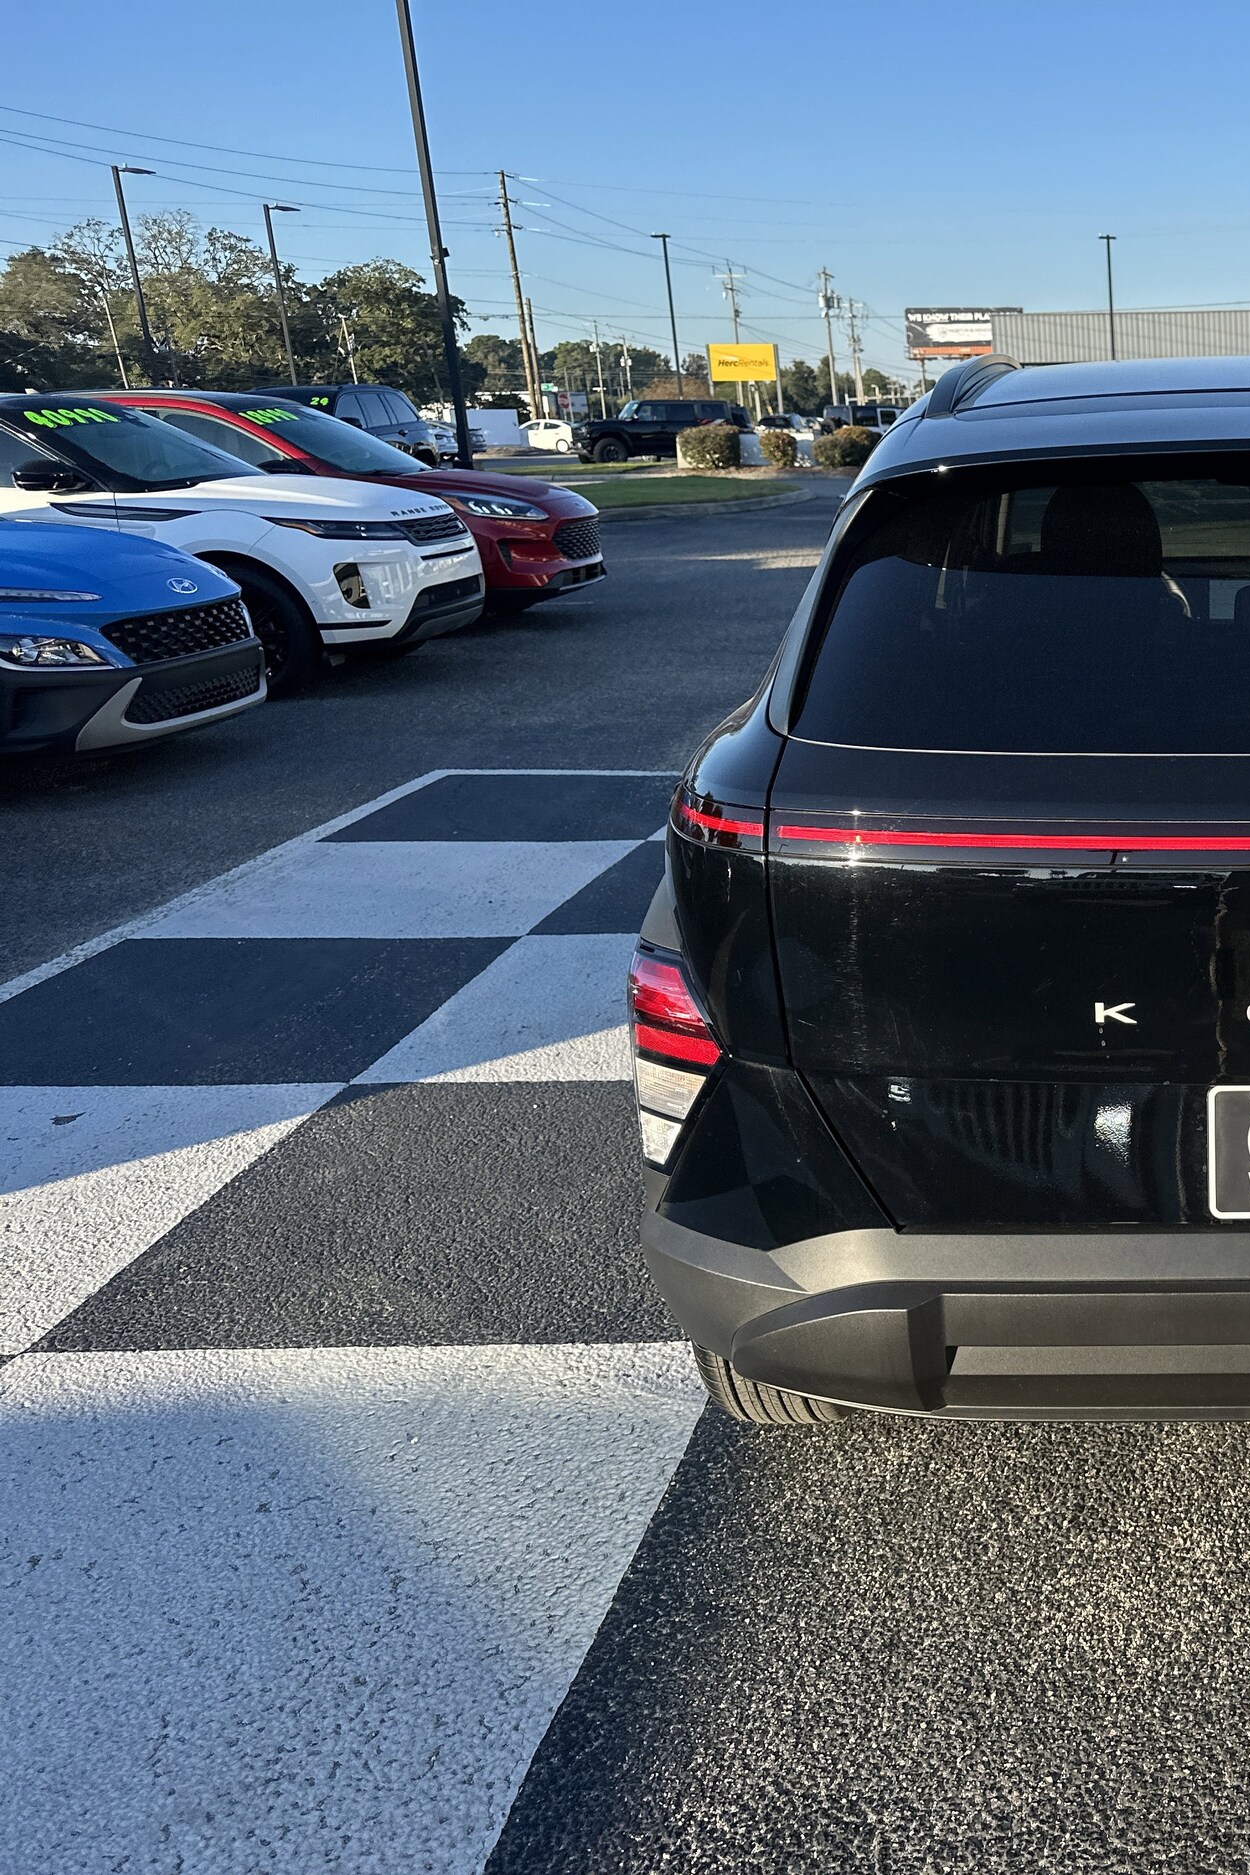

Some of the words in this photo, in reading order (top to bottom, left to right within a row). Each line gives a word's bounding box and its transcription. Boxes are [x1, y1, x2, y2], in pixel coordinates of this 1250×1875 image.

[718, 359, 770, 367] HercRentals
[309, 396, 329, 406] 24
[23, 407, 121, 429] 40990
[390, 507, 427, 517] RANGE
